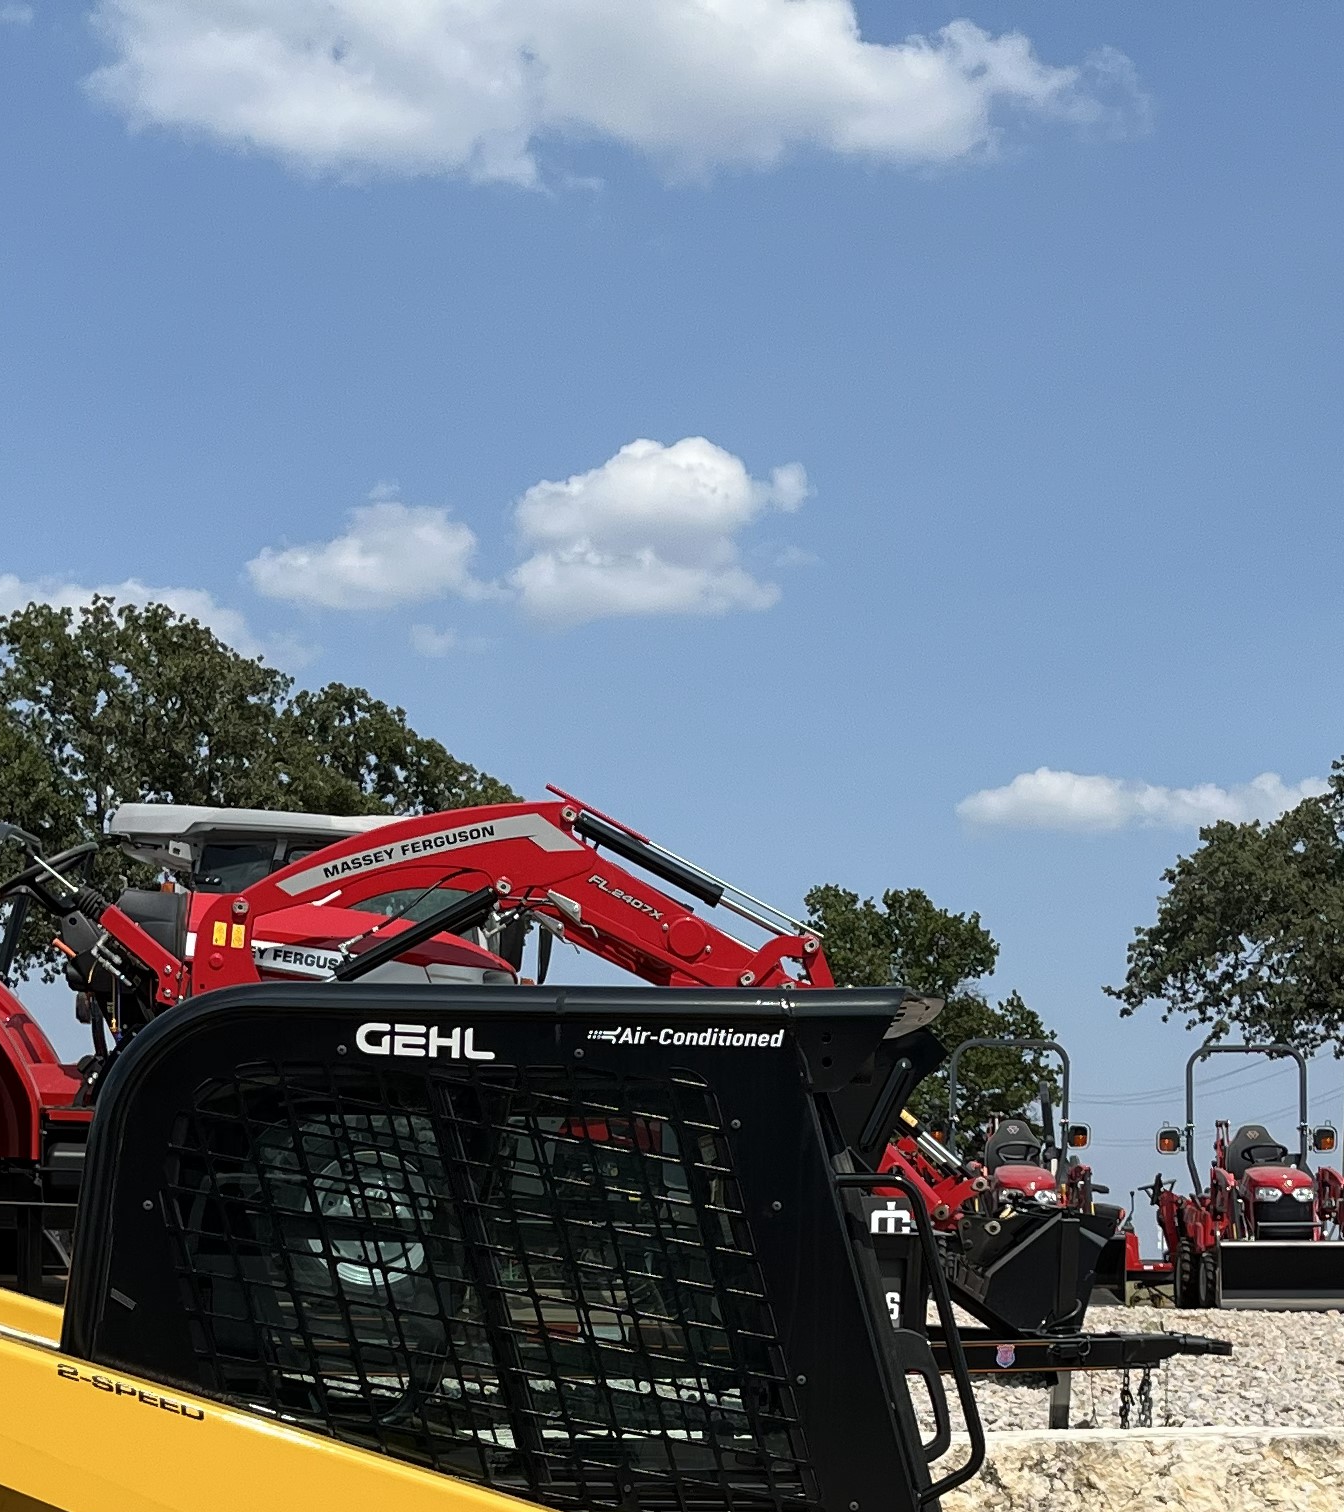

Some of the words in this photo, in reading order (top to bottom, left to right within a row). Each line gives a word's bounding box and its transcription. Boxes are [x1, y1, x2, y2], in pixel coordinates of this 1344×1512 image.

[323, 848, 395, 878] MASSEY
[401, 825, 495, 857] FERGUSON
[355, 1022, 496, 1060] GEHL
[619, 1028, 785, 1048] Air-Conditioned
[57, 1363, 205, 1421] 2-SPEED
